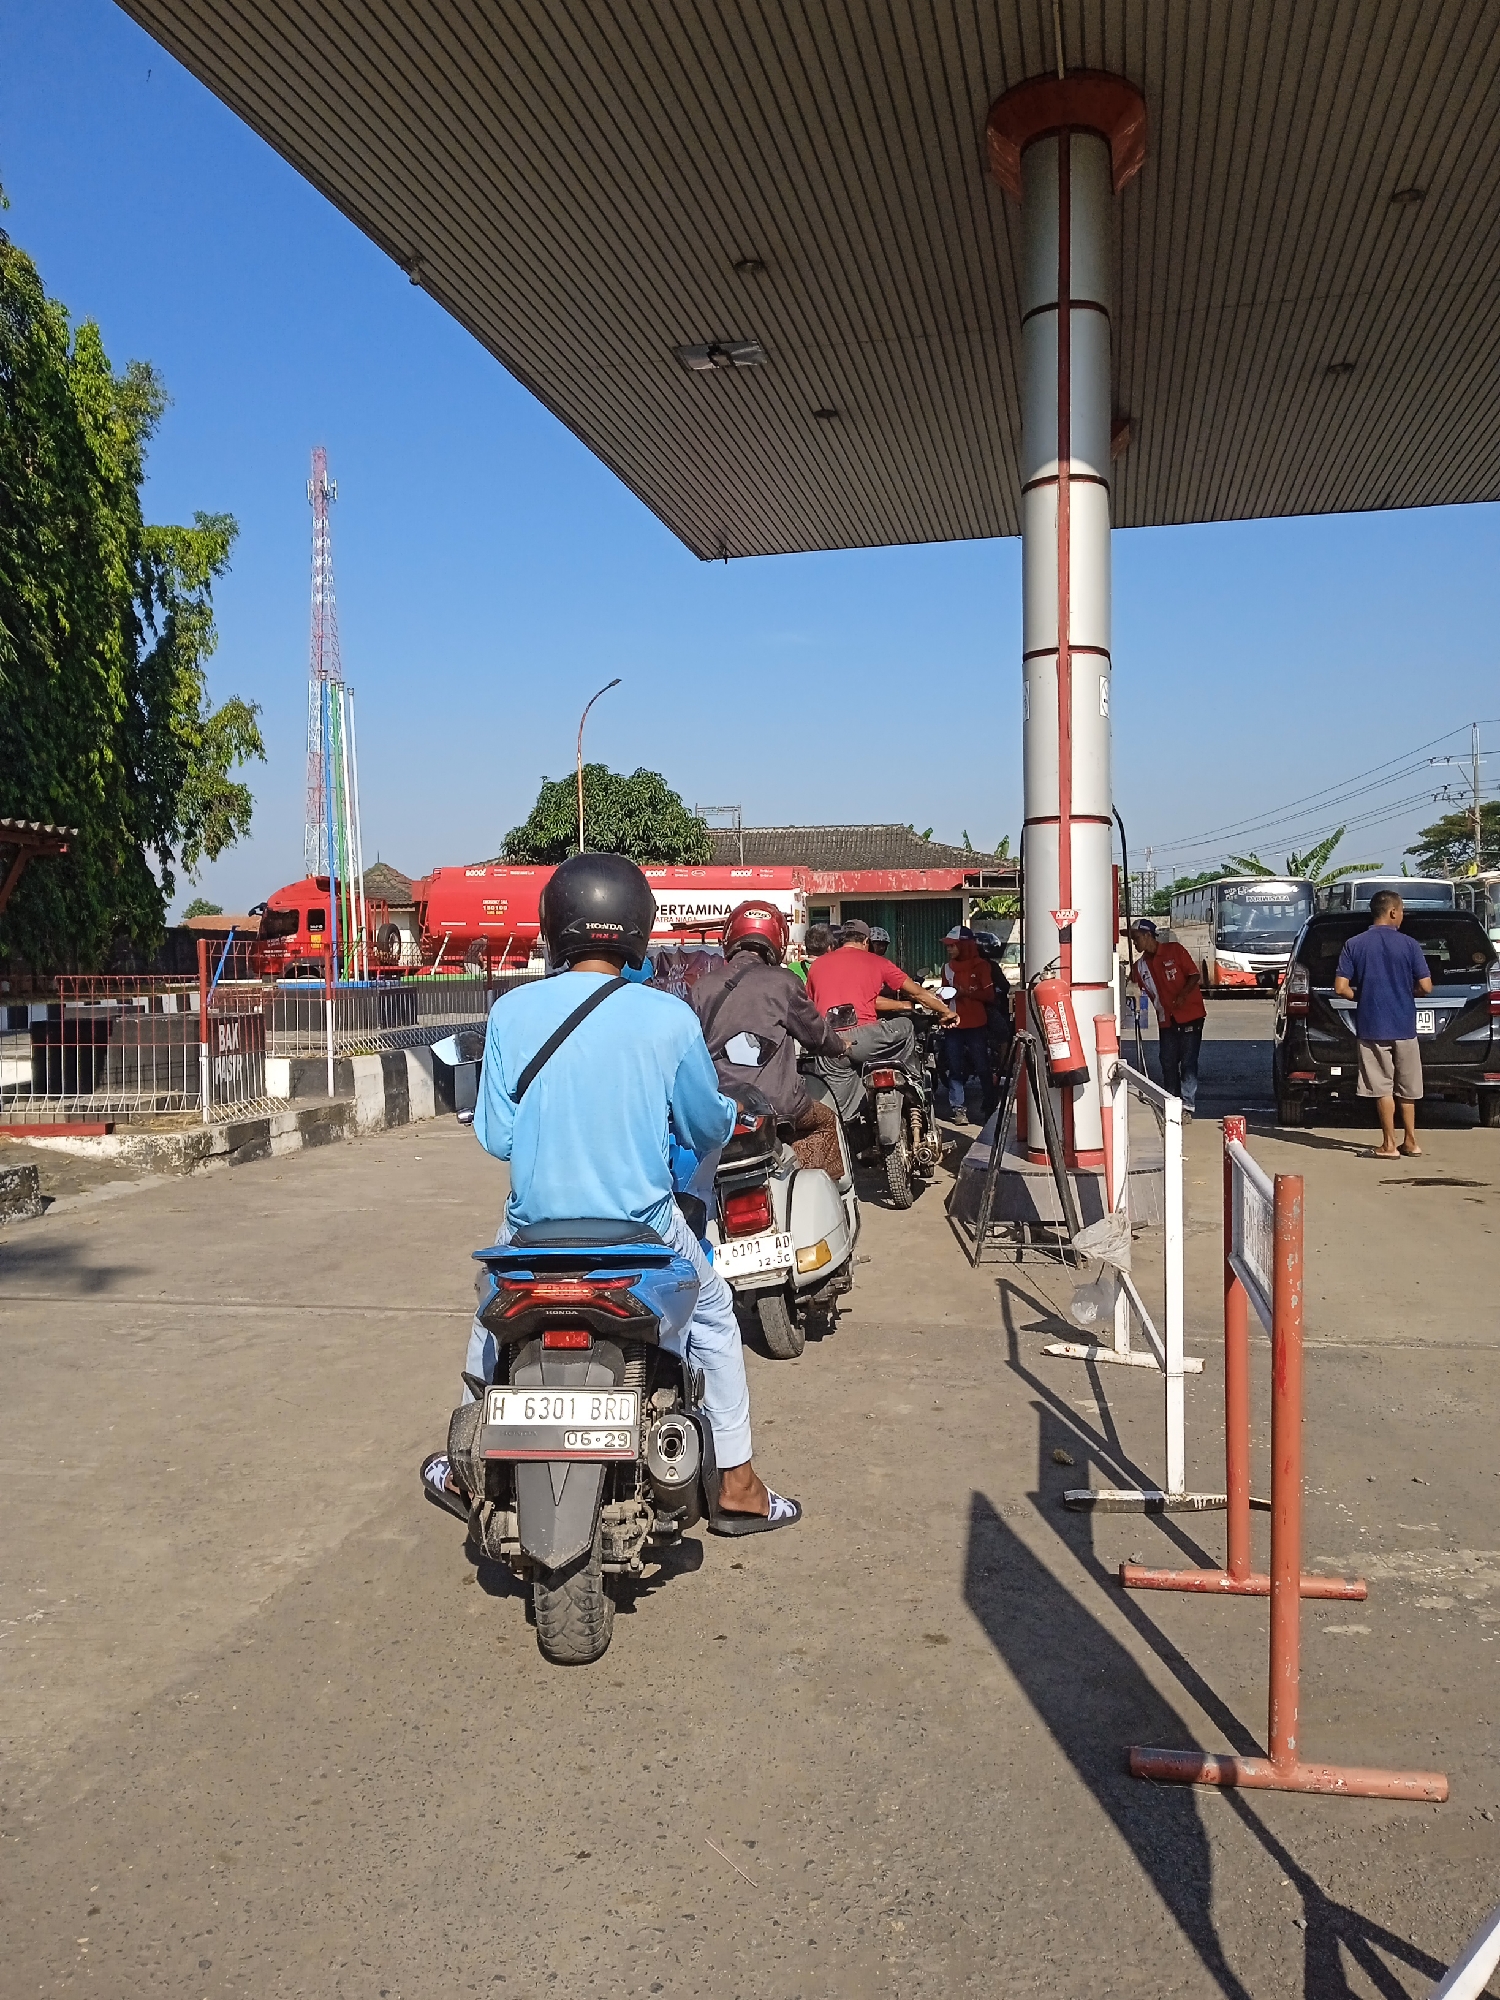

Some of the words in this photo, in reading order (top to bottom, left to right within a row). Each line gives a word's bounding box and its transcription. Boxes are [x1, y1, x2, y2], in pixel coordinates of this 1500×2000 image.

[586, 923, 624, 931] HONDA
[1418, 1012, 1431, 1024] AD
[219, 1023, 239, 1051] BAK
[775, 1235, 790, 1249] AD
[492, 1397, 505, 1420] H
[524, 1397, 575, 1420] 6301
[591, 1397, 631, 1420] BRD
